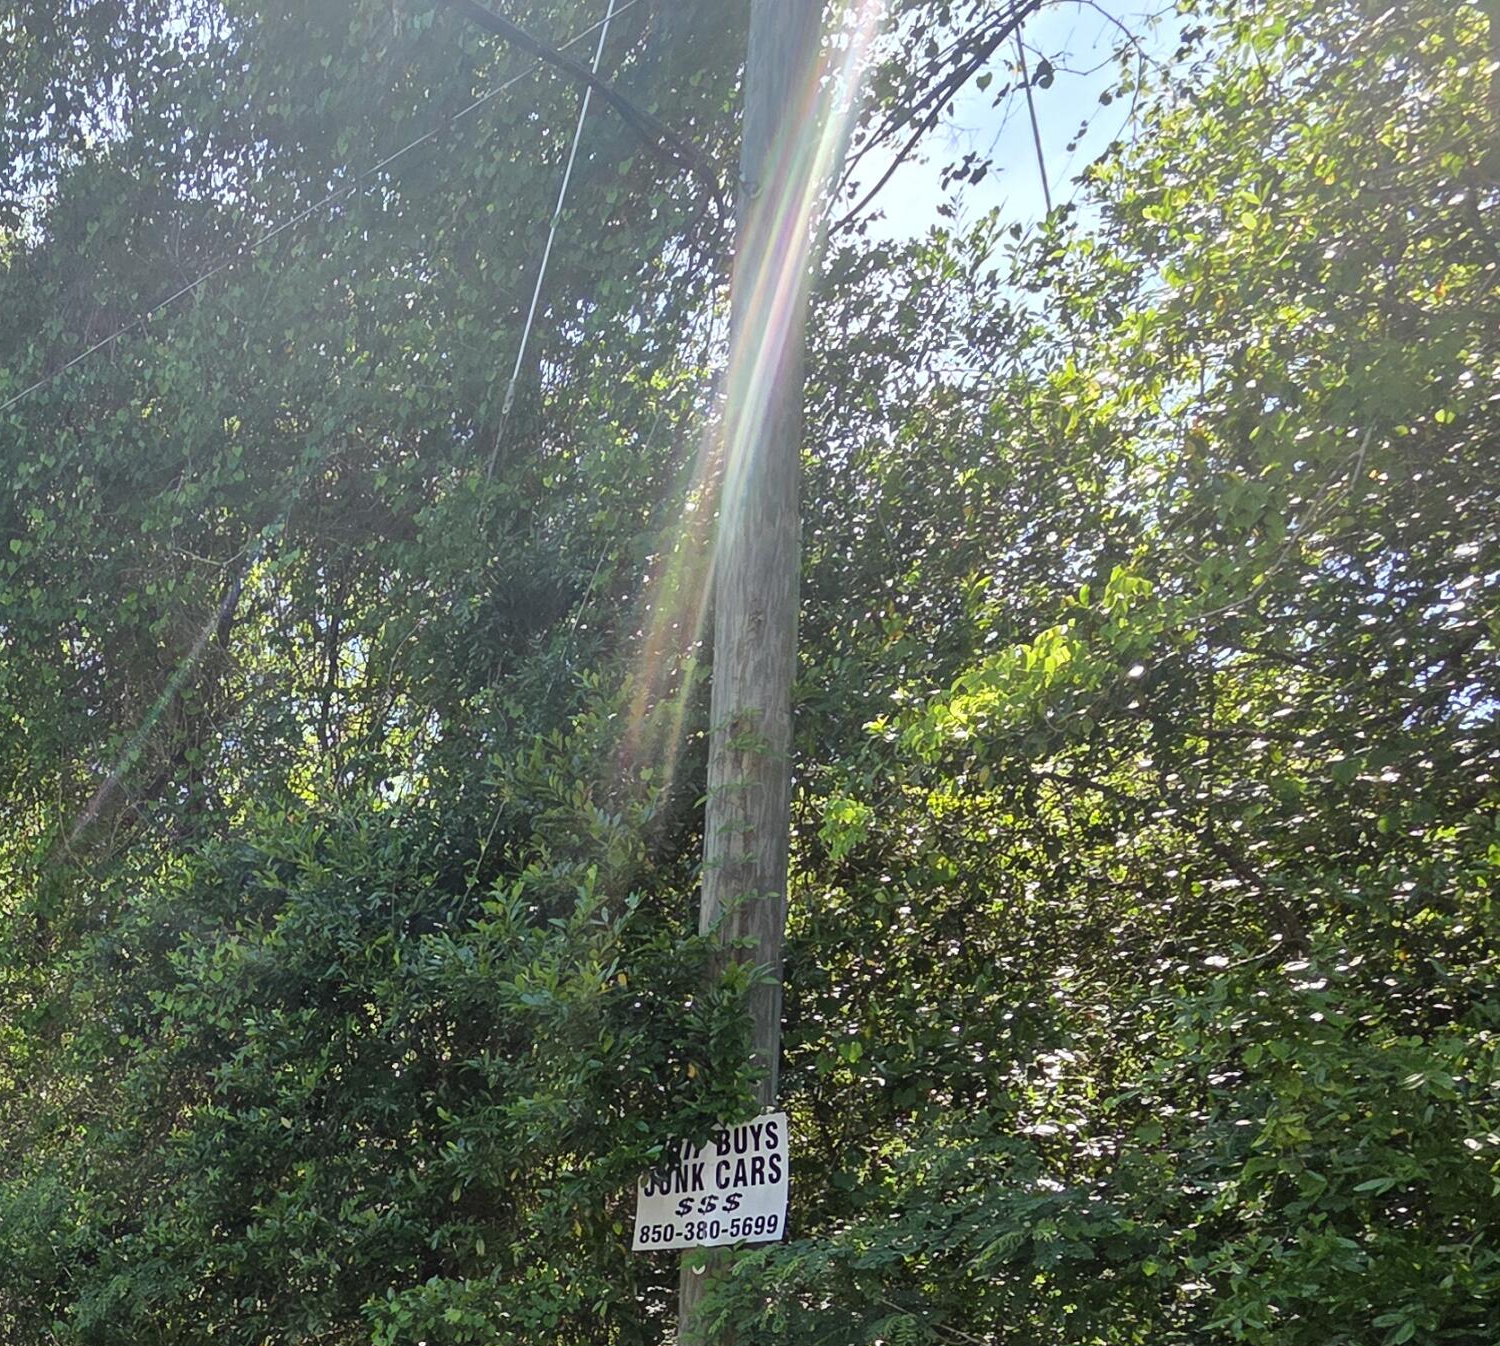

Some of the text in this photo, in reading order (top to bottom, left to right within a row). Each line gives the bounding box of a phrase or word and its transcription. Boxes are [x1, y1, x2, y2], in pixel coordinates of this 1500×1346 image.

[715, 1121, 779, 1156] BUYS
[715, 1153, 782, 1190] CARS
[639, 1214, 779, 1244] 850-380-5699
